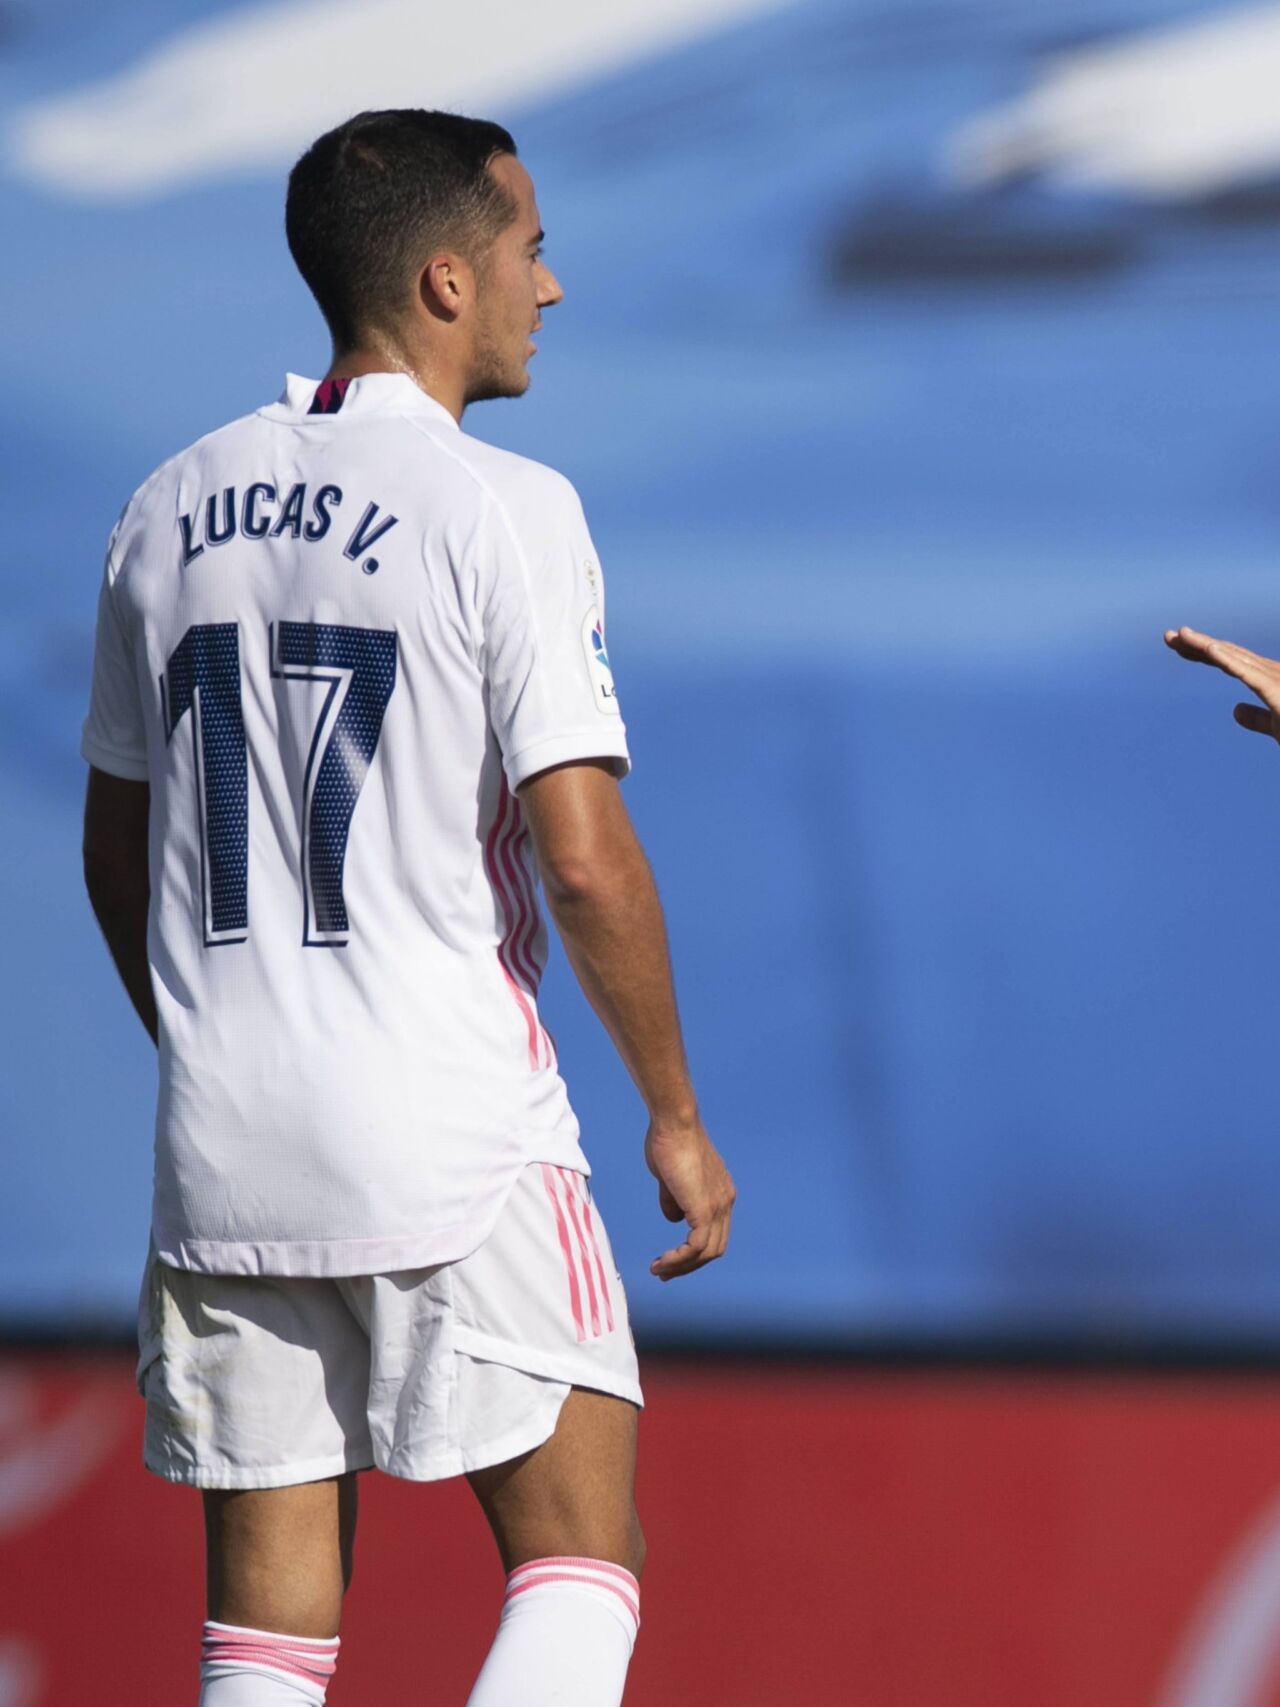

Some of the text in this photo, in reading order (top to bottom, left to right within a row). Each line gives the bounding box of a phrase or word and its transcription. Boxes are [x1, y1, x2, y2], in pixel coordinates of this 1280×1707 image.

[178, 482, 399, 576] LUCAS V.
[159, 620, 398, 948] 17
